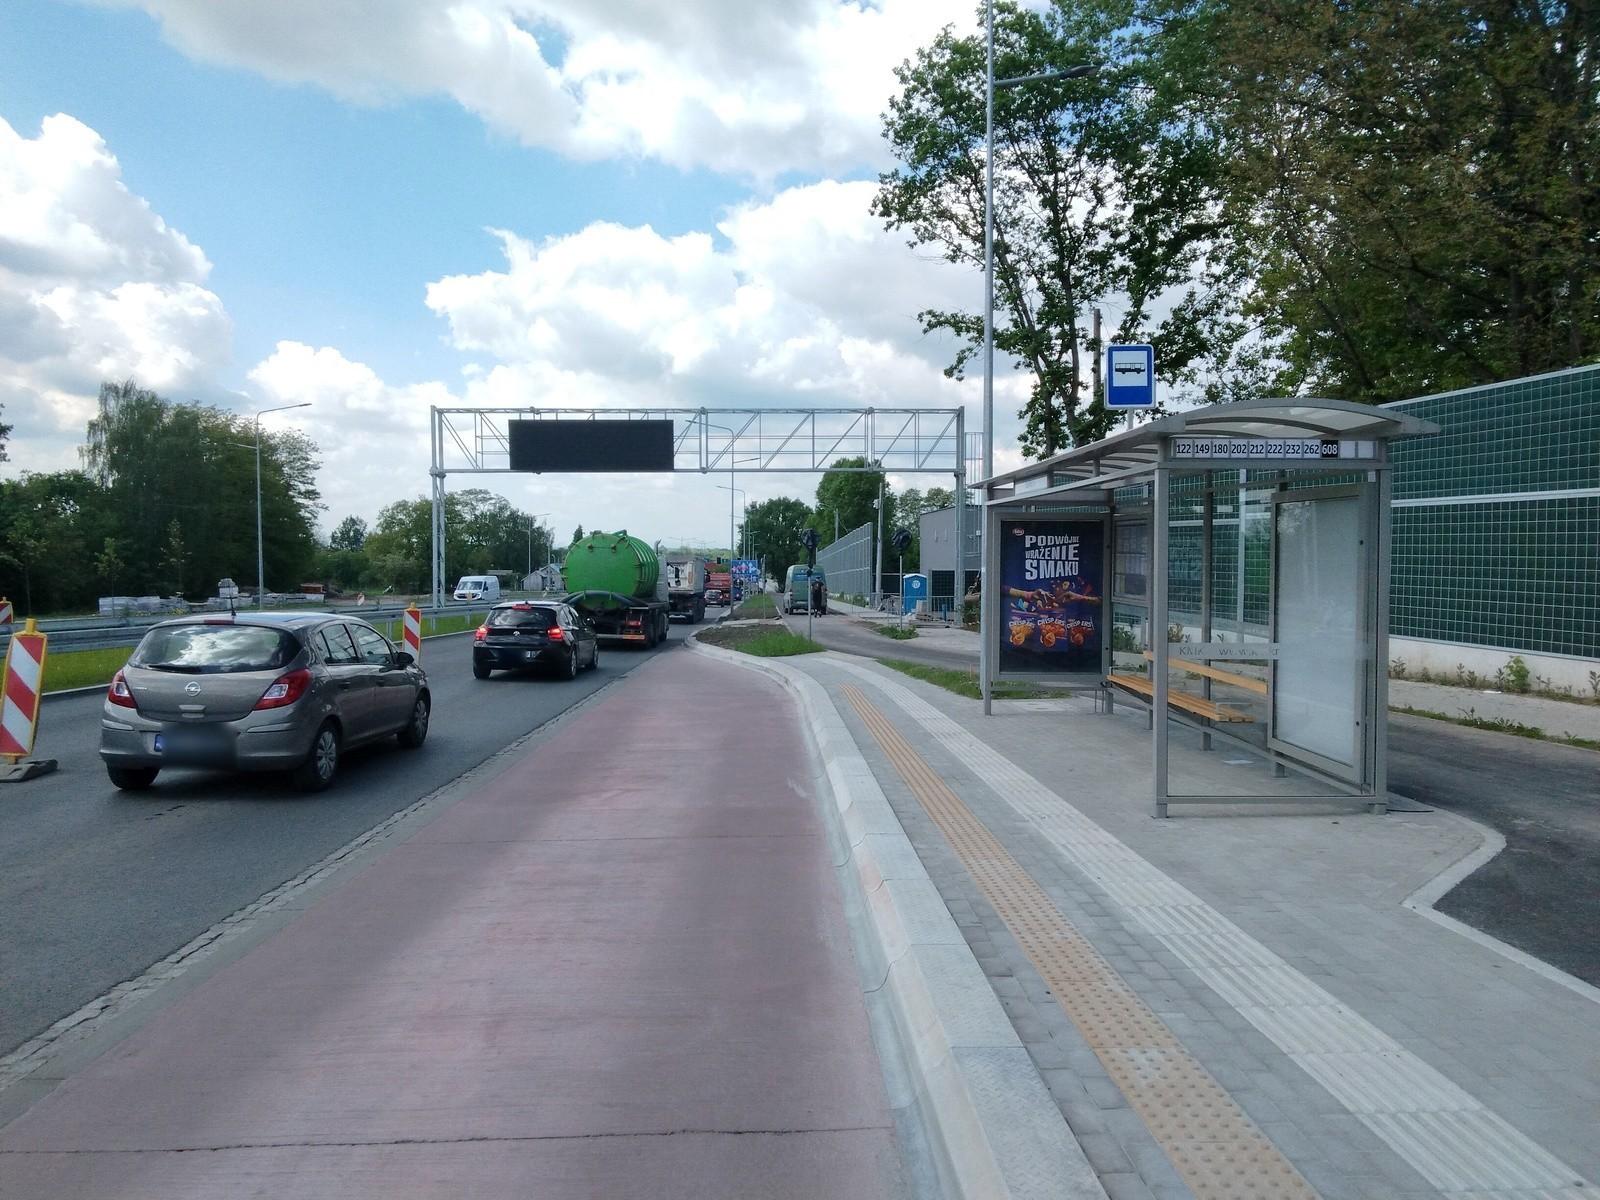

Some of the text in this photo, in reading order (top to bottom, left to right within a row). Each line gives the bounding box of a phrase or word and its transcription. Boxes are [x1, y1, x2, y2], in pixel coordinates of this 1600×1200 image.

[1176, 444, 1338, 454] 122 149 180 202 212 222 232 262 608
[1025, 534, 1079, 547] PODWÓJNE
[1025, 545, 1079, 560] WRAŻENIE
[1025, 559, 1079, 580] SMAKU
